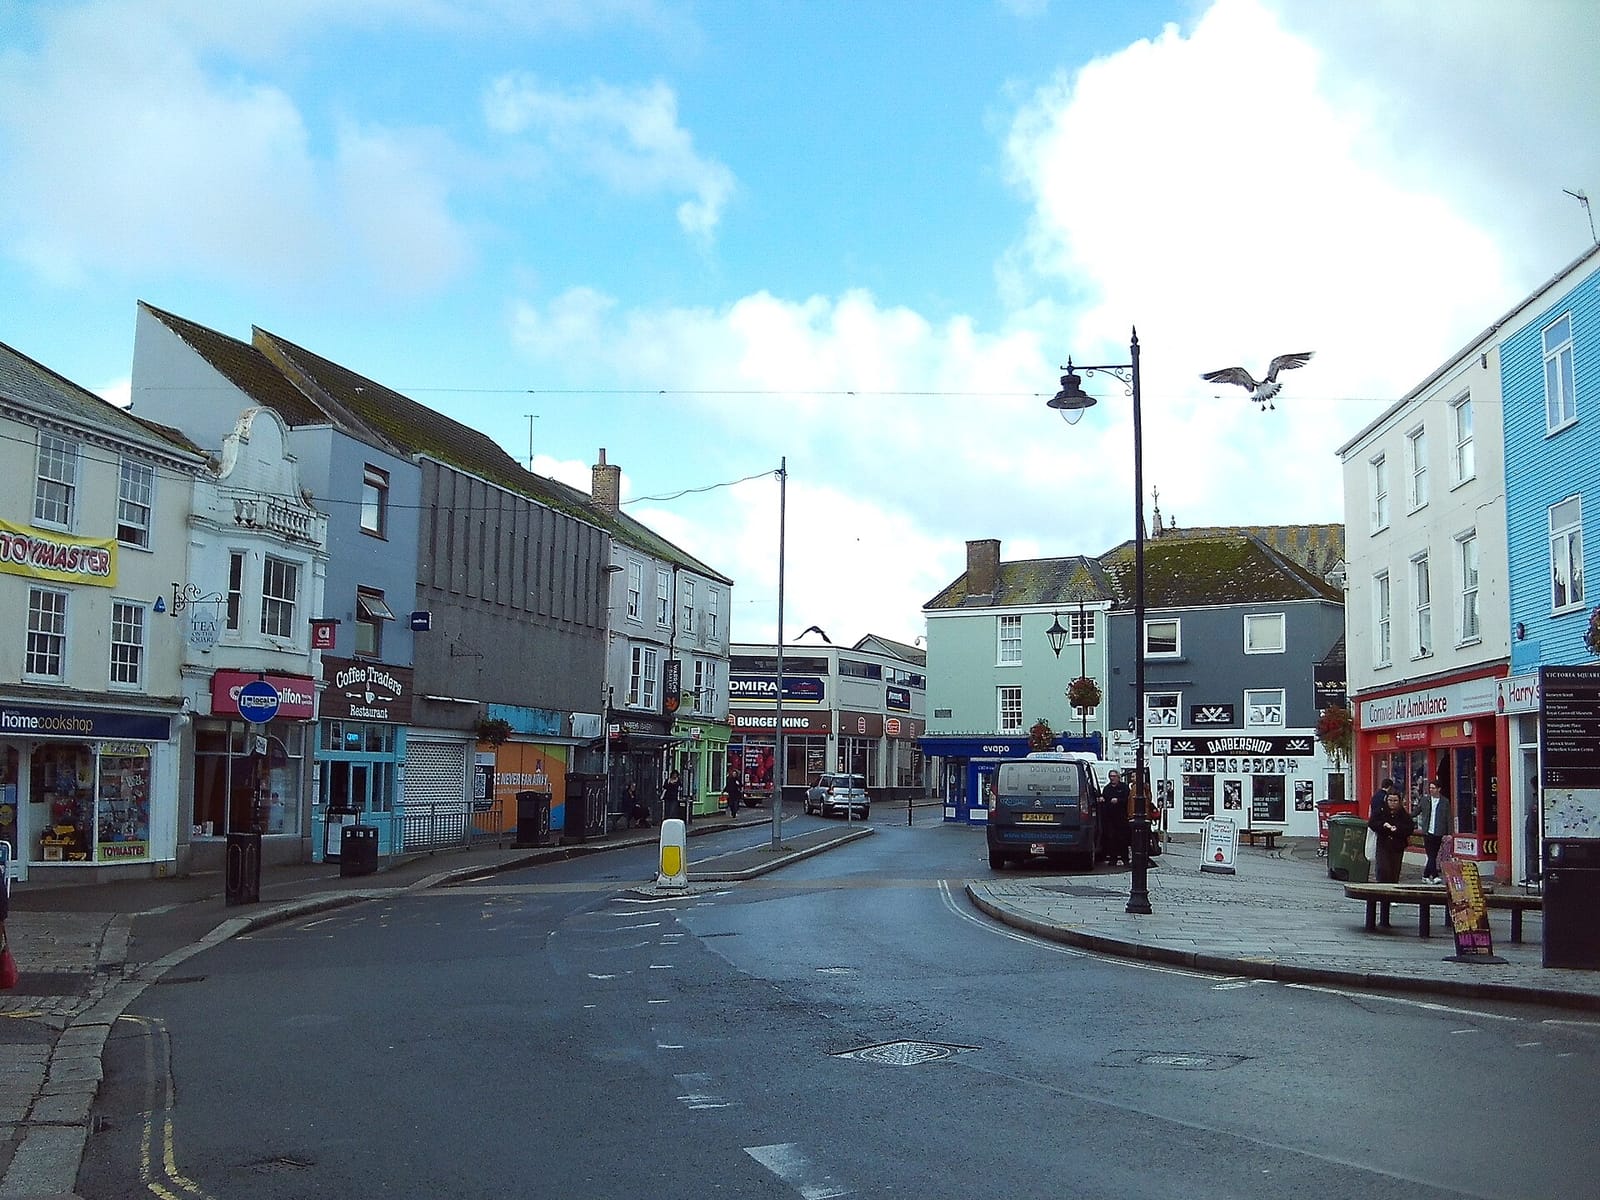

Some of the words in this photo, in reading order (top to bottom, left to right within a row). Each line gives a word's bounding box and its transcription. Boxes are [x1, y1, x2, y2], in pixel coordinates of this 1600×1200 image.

[0, 531, 110, 577] TOYMASTER
[192, 621, 216, 631] TEA
[336, 667, 366, 689] Coffee
[367, 666, 402, 696] Traders
[729, 681, 789, 693] DMIRA
[350, 704, 388, 719] Restaurant
[1369, 702, 1395, 723] Cornwall
[1396, 699, 1406, 719] Air
[1406, 693, 1447, 718] Ambulance
[1, 711, 93, 734] homecookshop
[782, 717, 809, 728] KING
[982, 745, 1010, 755] evapo
[1207, 737, 1273, 754] BARBERSHOP
[102, 845, 145, 857] TOYMASTER
